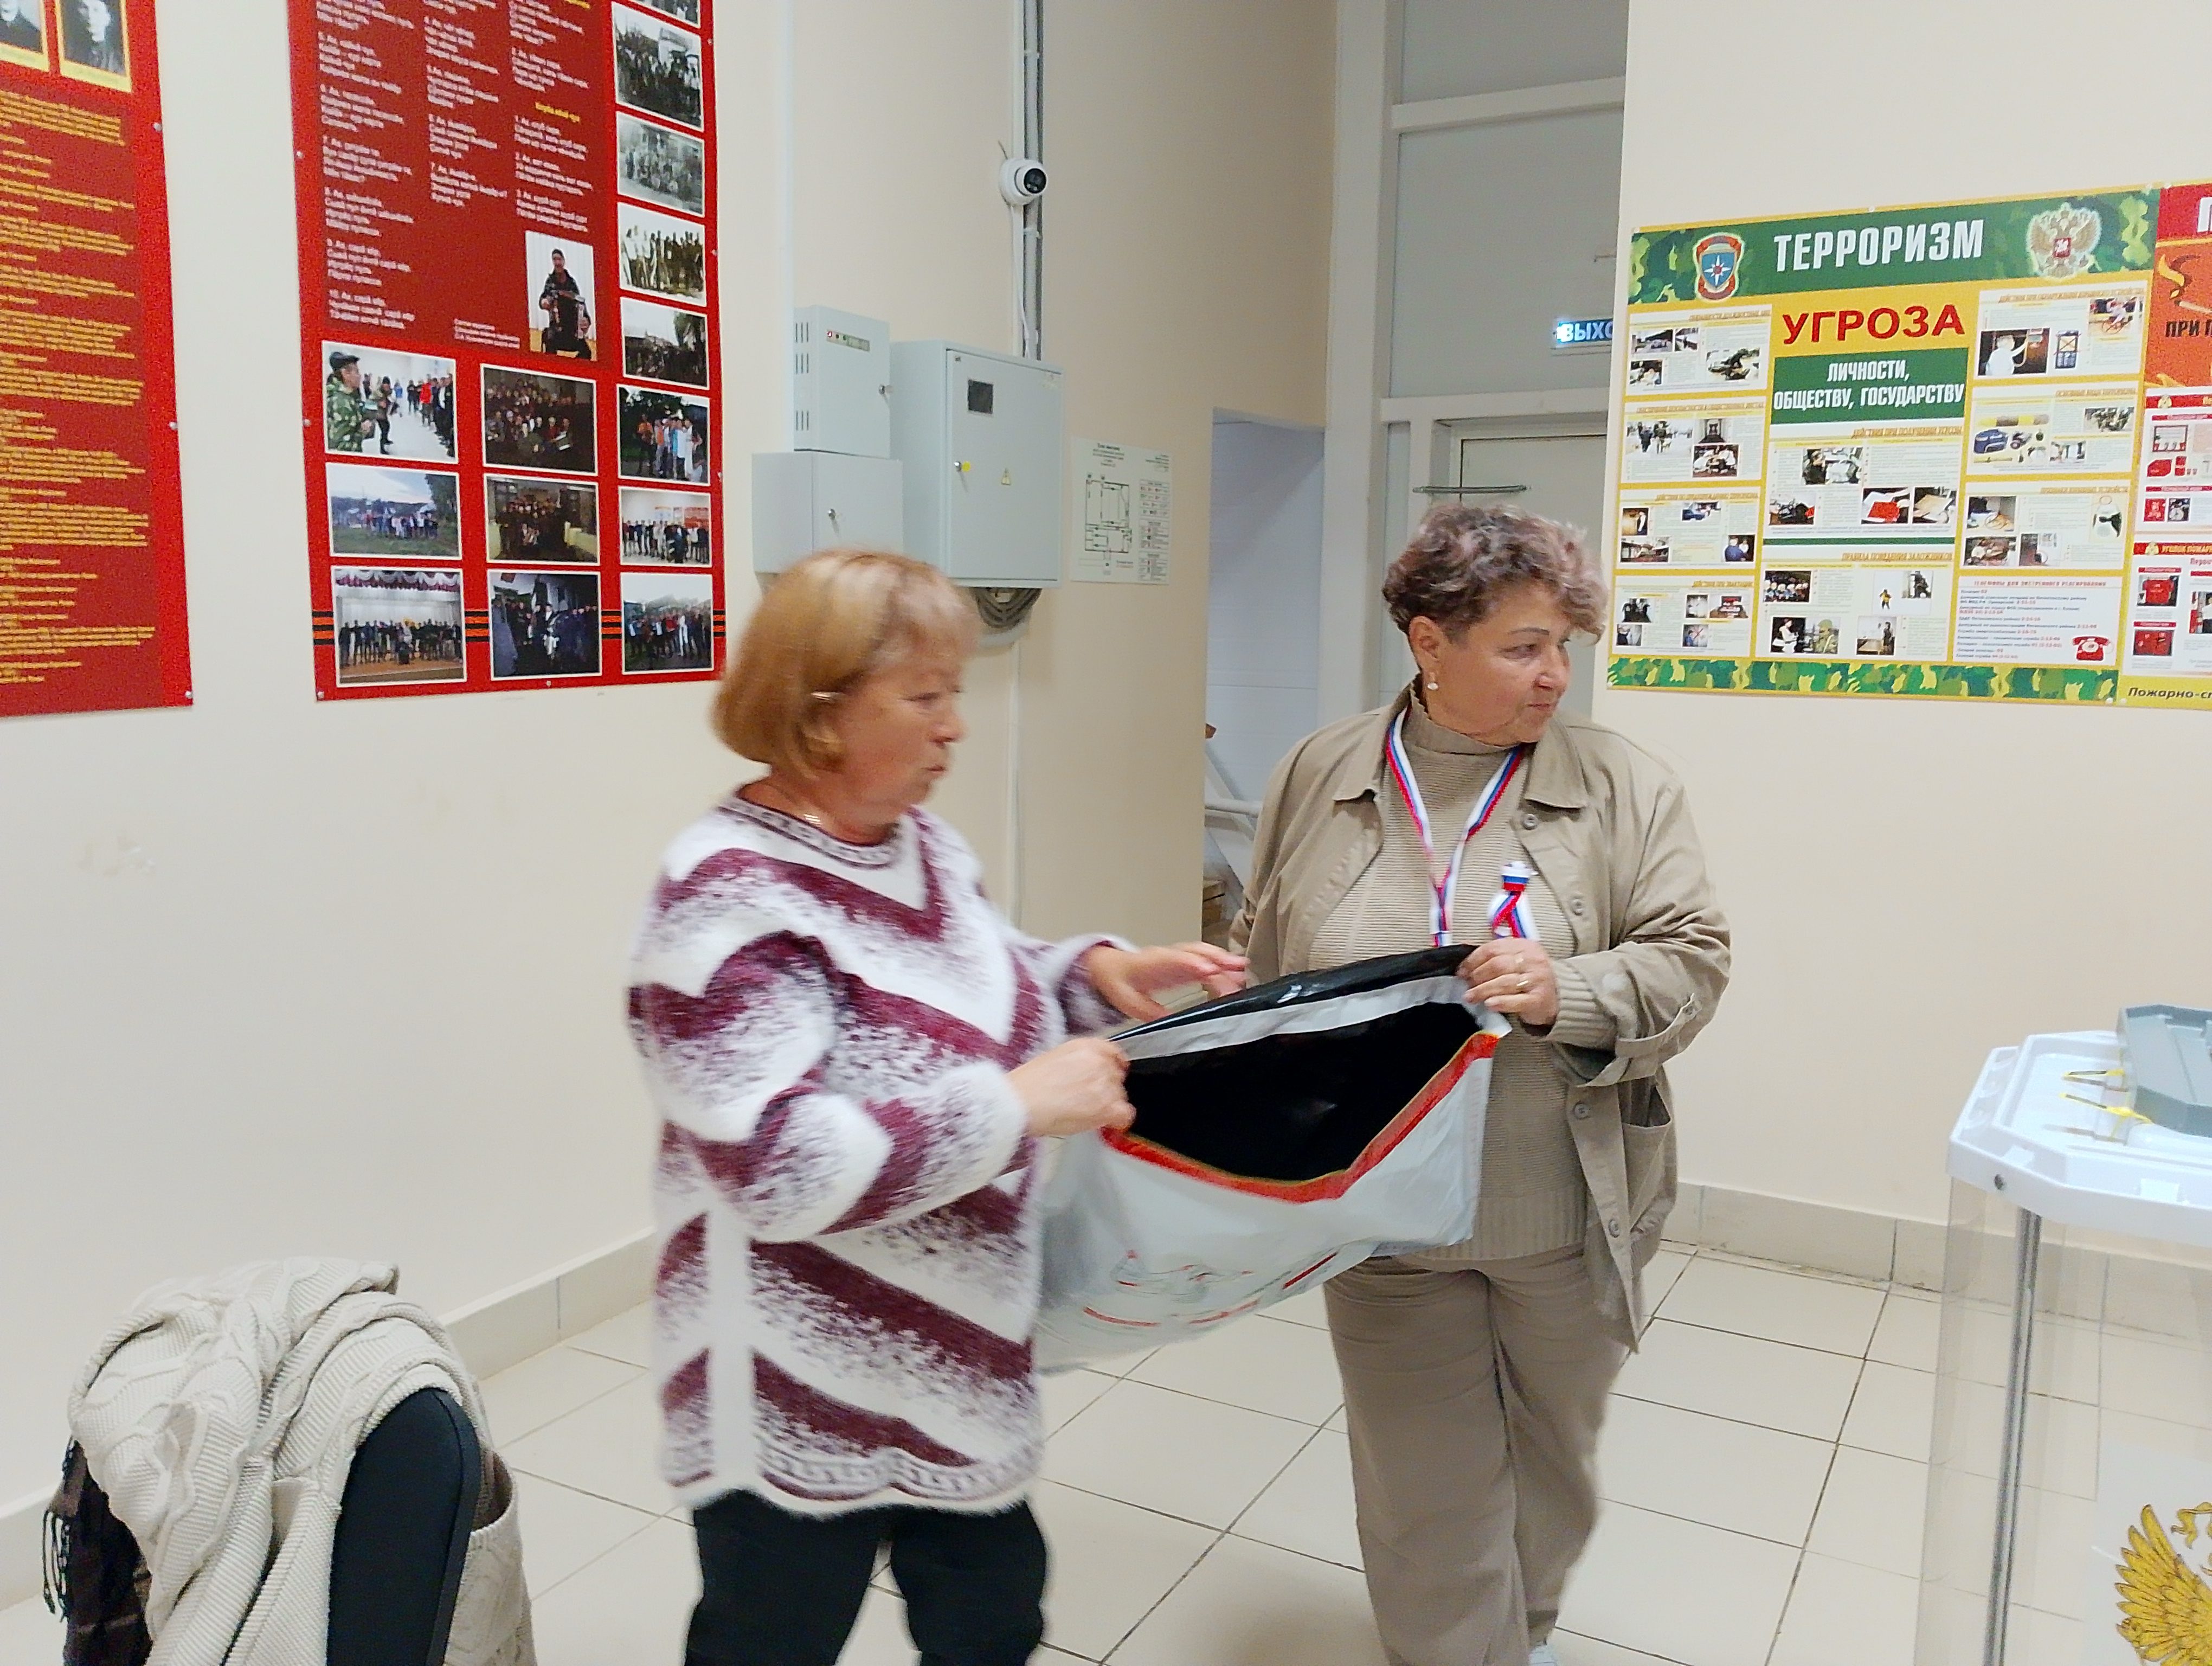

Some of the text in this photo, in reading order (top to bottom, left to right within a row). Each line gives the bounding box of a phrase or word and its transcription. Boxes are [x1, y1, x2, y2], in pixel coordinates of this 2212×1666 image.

[1774, 219, 1984, 272] ТЕРРОРИЗМ
[1782, 304, 1965, 344] УГРОЗА
[2165, 319, 2200, 337] ПРИ
[1827, 360, 1910, 382] ЛИЧНОСТИ,
[1773, 388, 1854, 411] ОБЩЕСТВУ,
[1860, 383, 1965, 408] ГОСУДАРСТВУ
